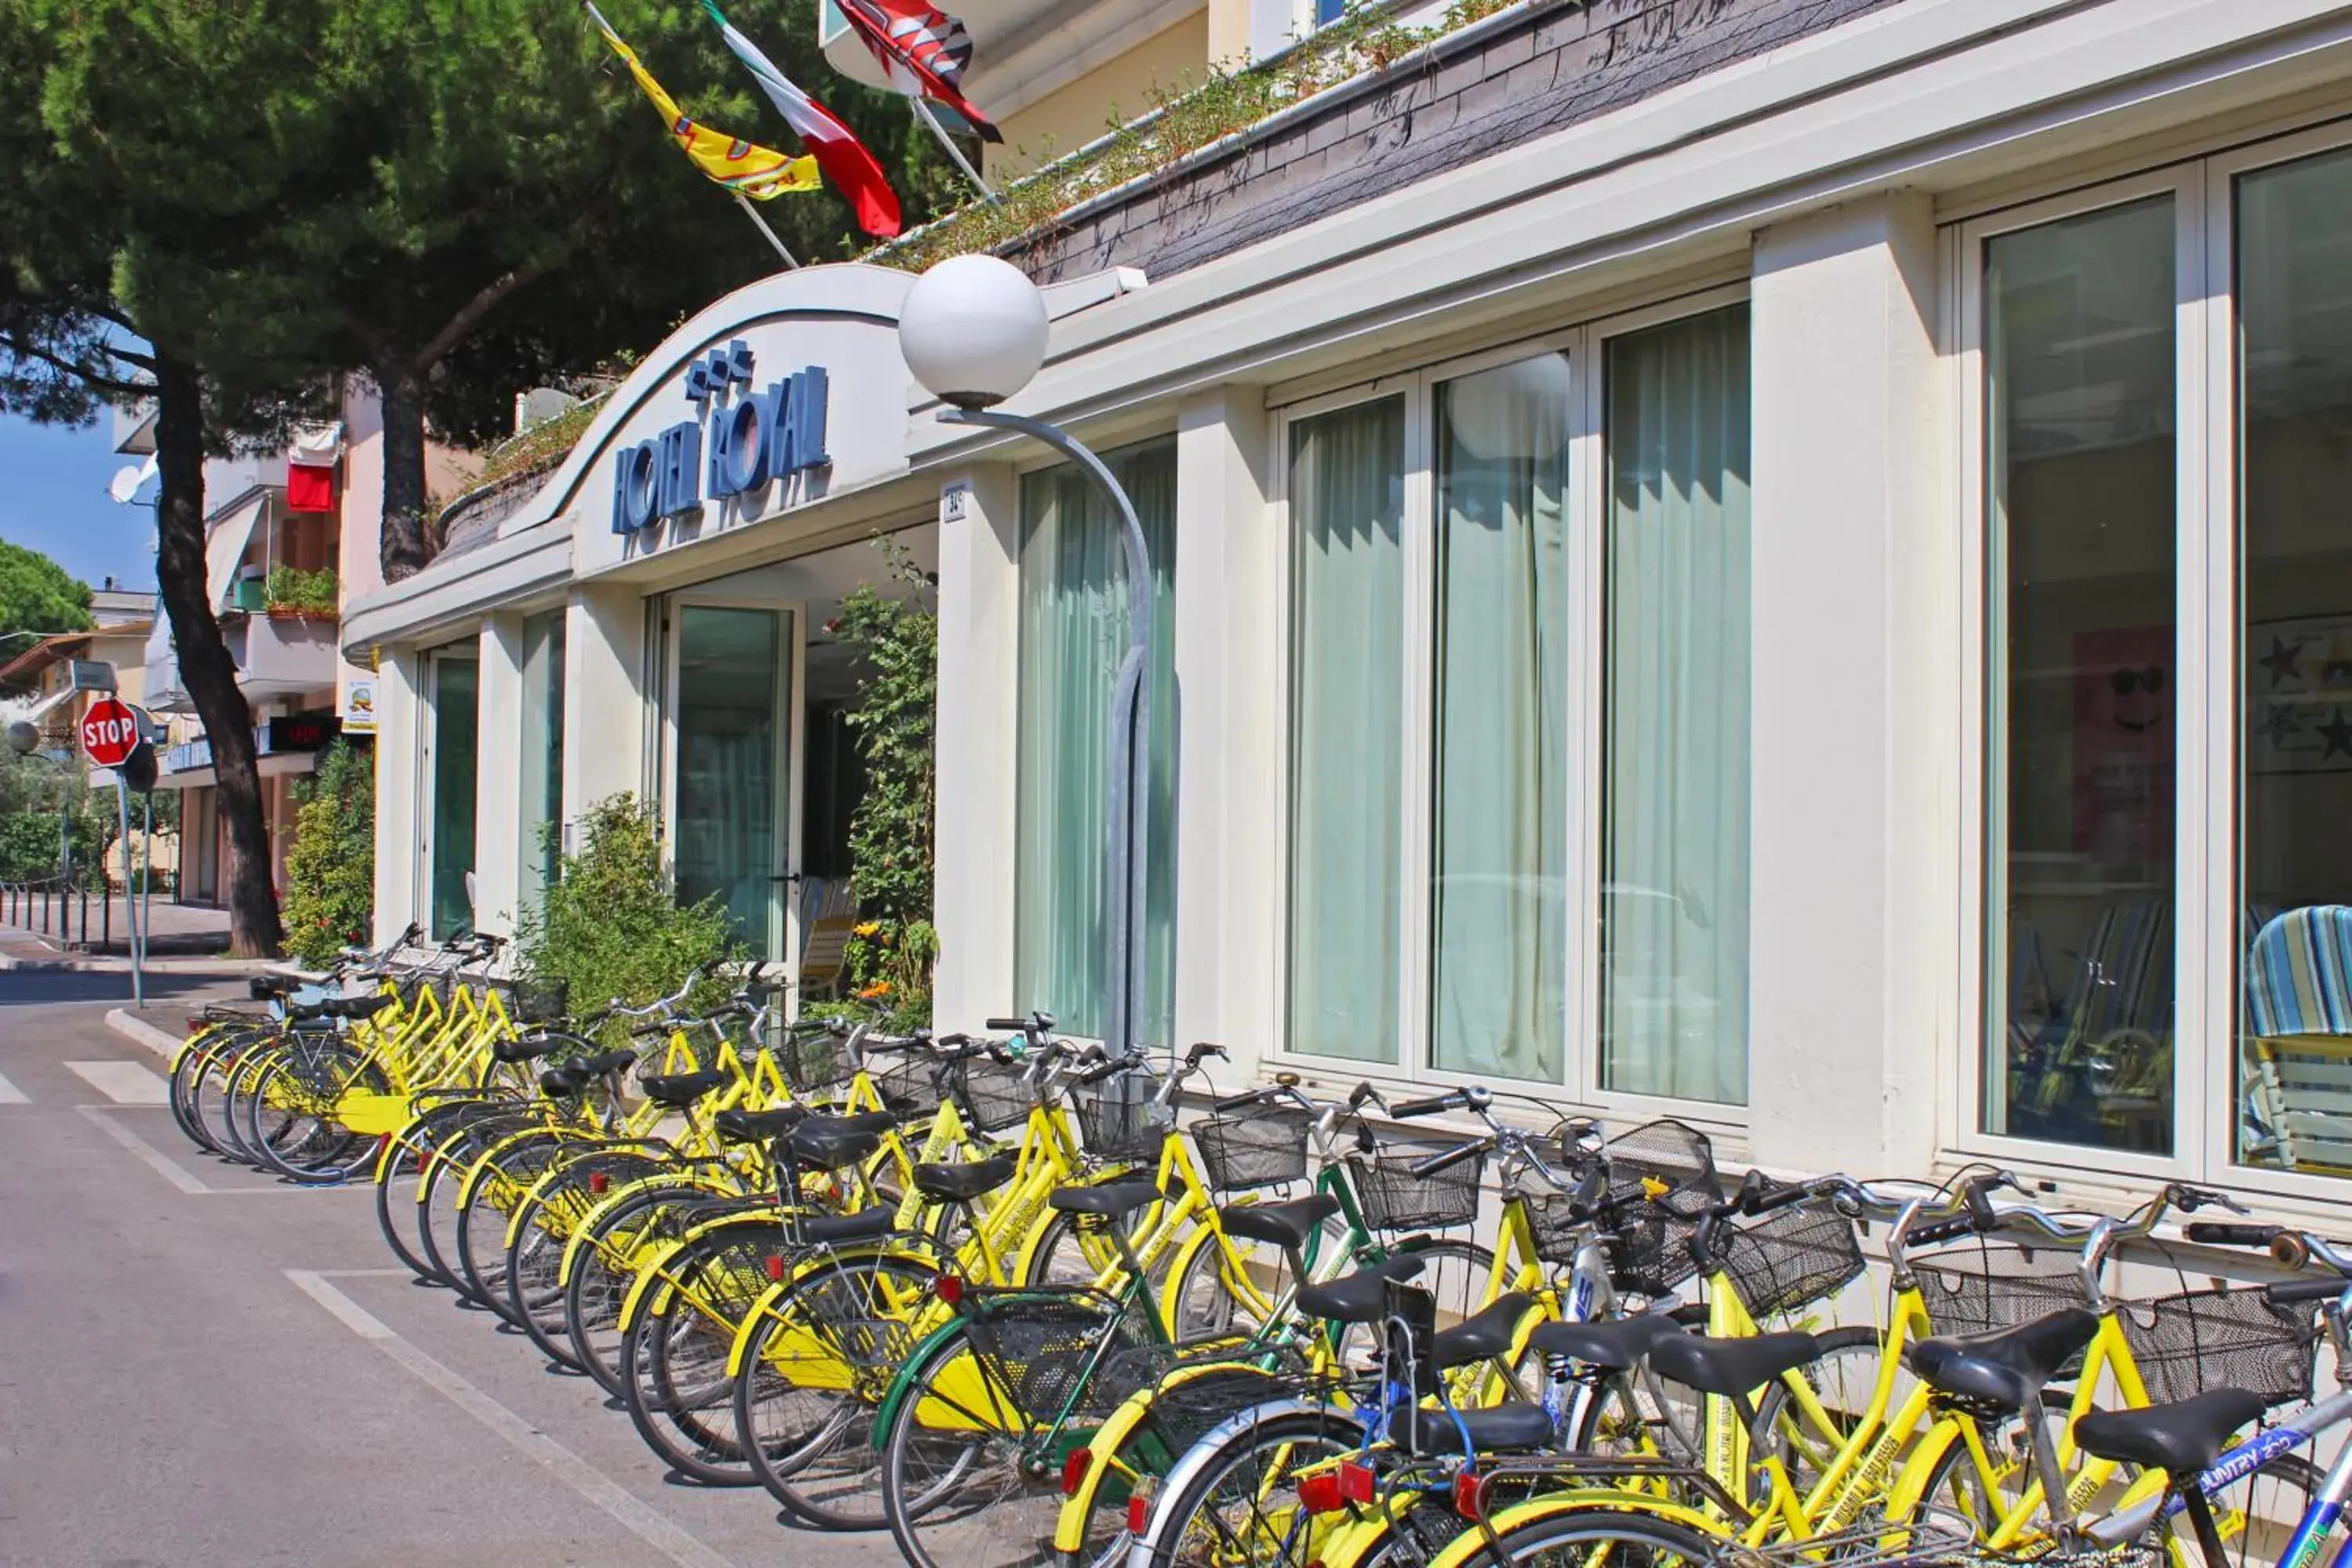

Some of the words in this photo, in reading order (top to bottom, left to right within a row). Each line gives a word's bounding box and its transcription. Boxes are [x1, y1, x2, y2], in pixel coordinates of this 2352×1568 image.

[612, 421, 702, 535] HOTEL
[707, 365, 831, 500] ROYAL
[85, 717, 132, 747] STOP
